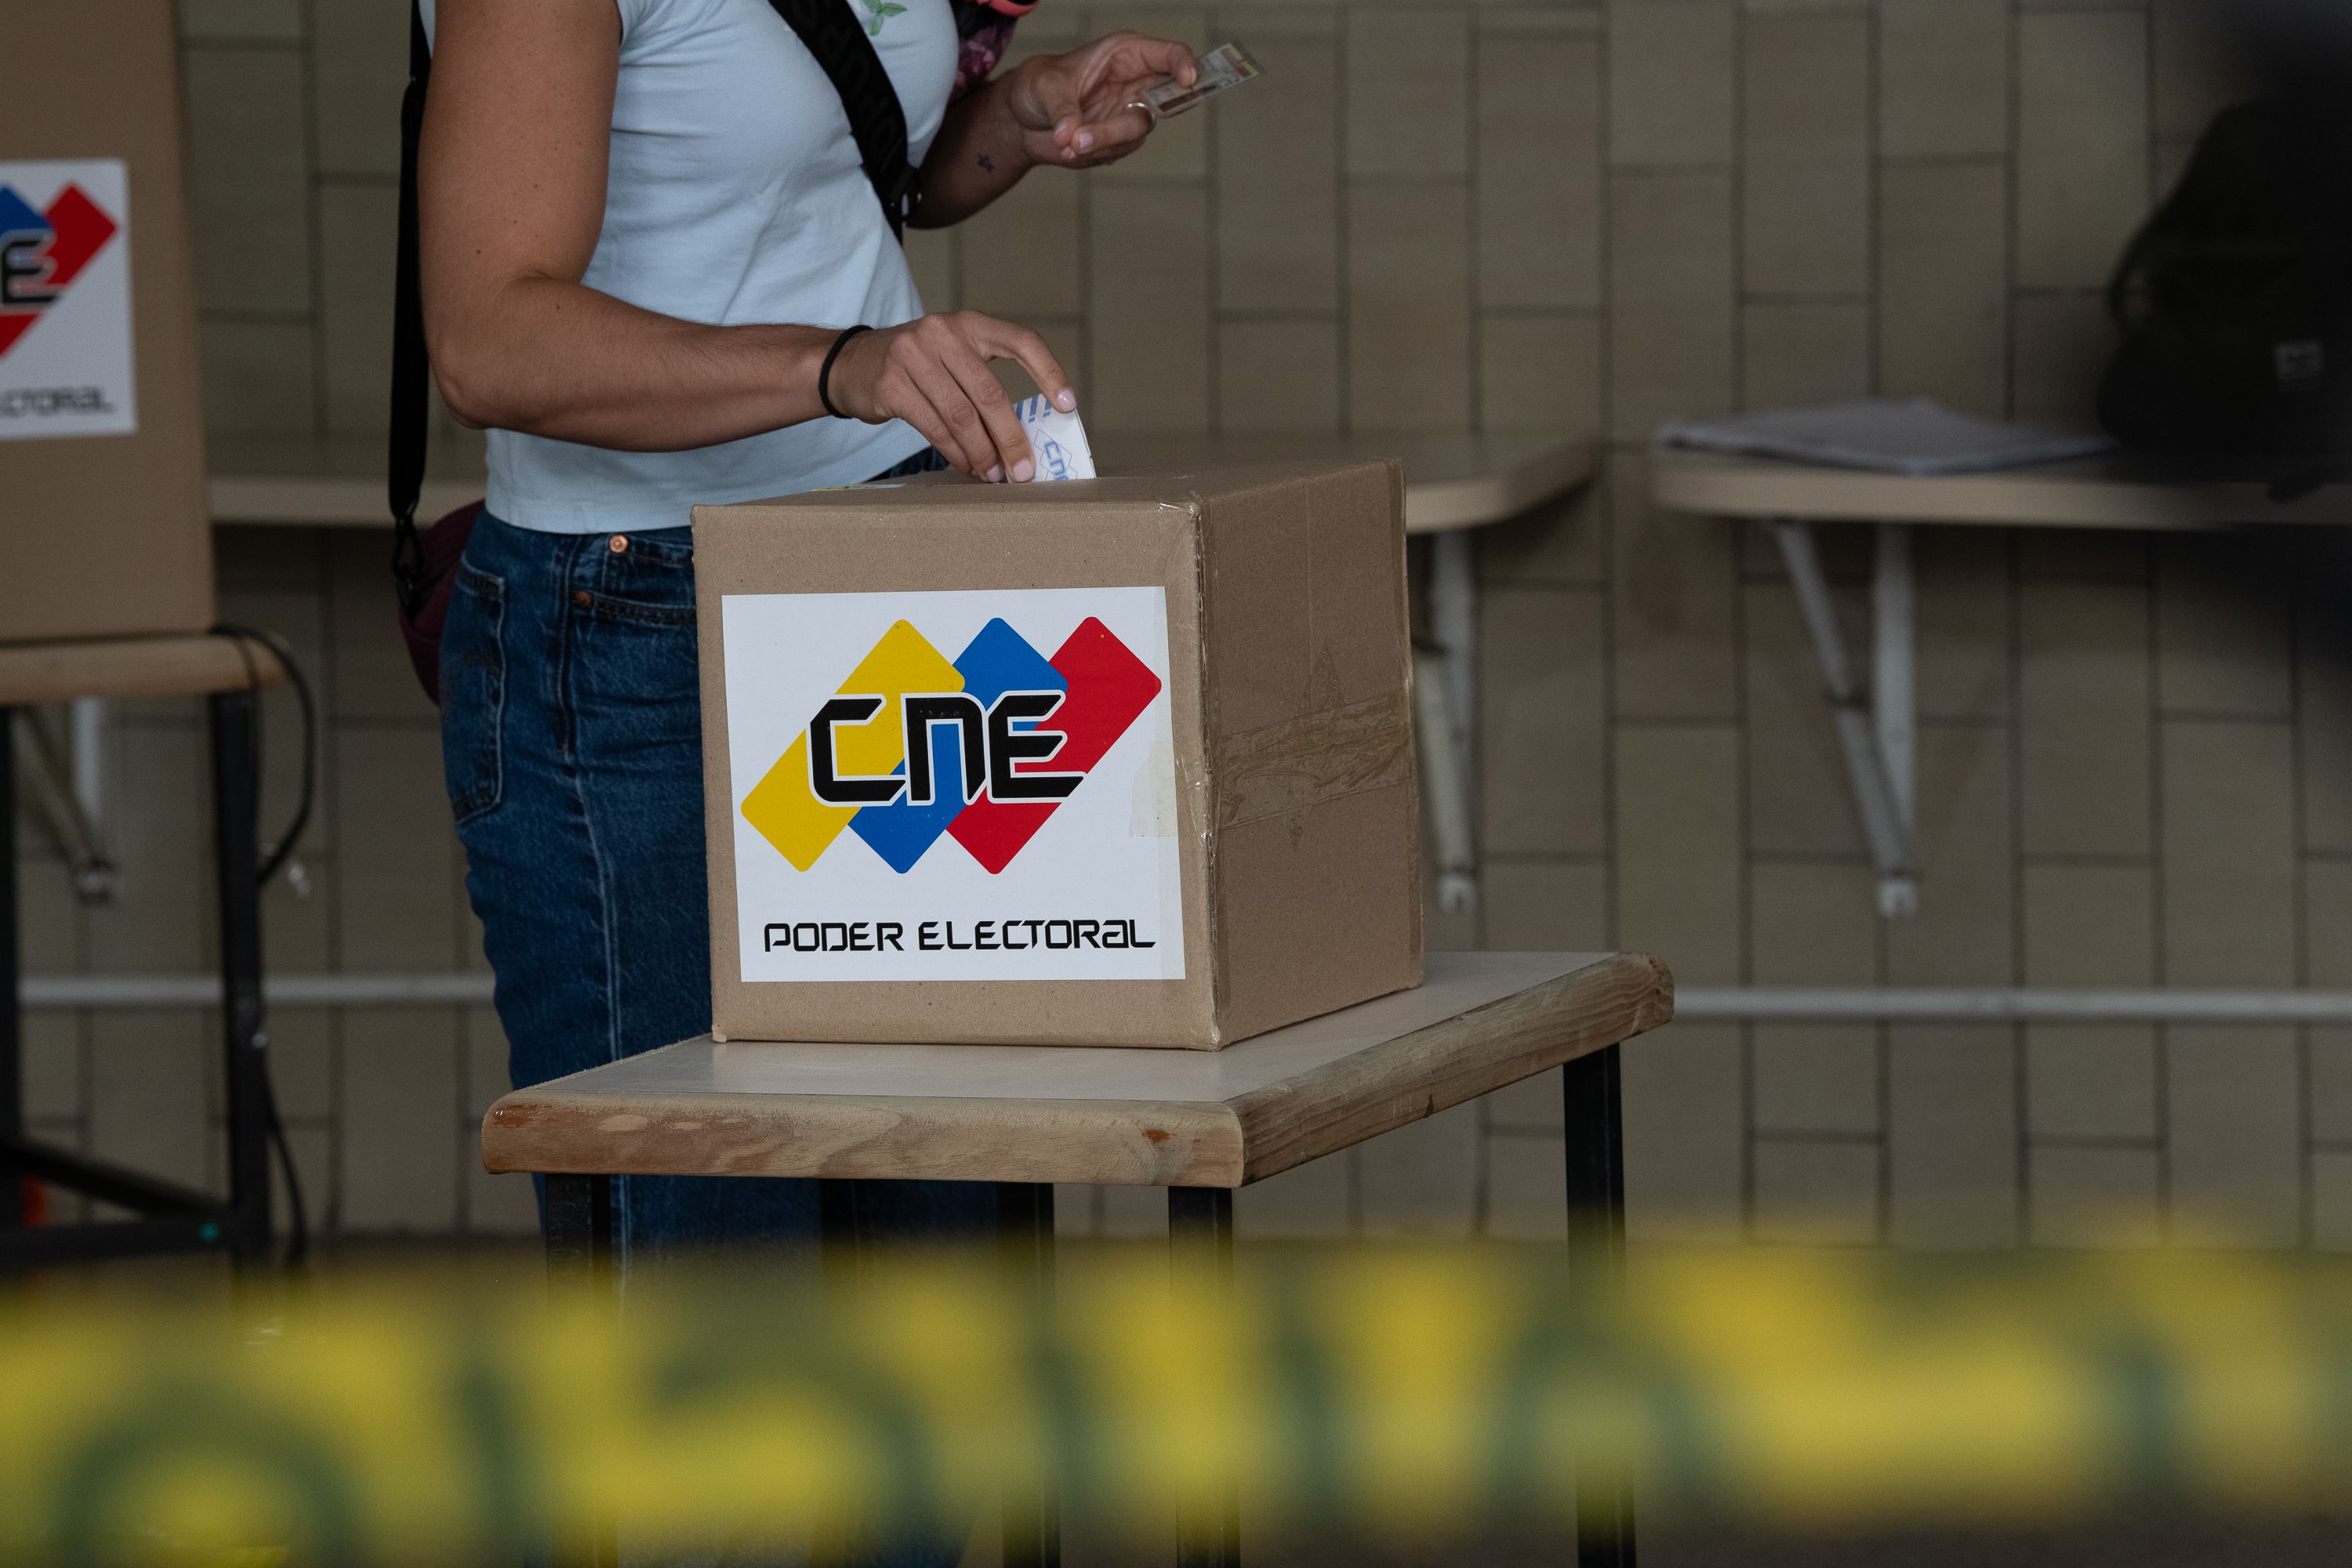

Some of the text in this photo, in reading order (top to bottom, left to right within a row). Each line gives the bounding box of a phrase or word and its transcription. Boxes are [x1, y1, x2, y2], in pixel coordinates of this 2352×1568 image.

[809, 693, 1086, 804] CNE
[764, 919, 1156, 953] PODER ELECTORAL
